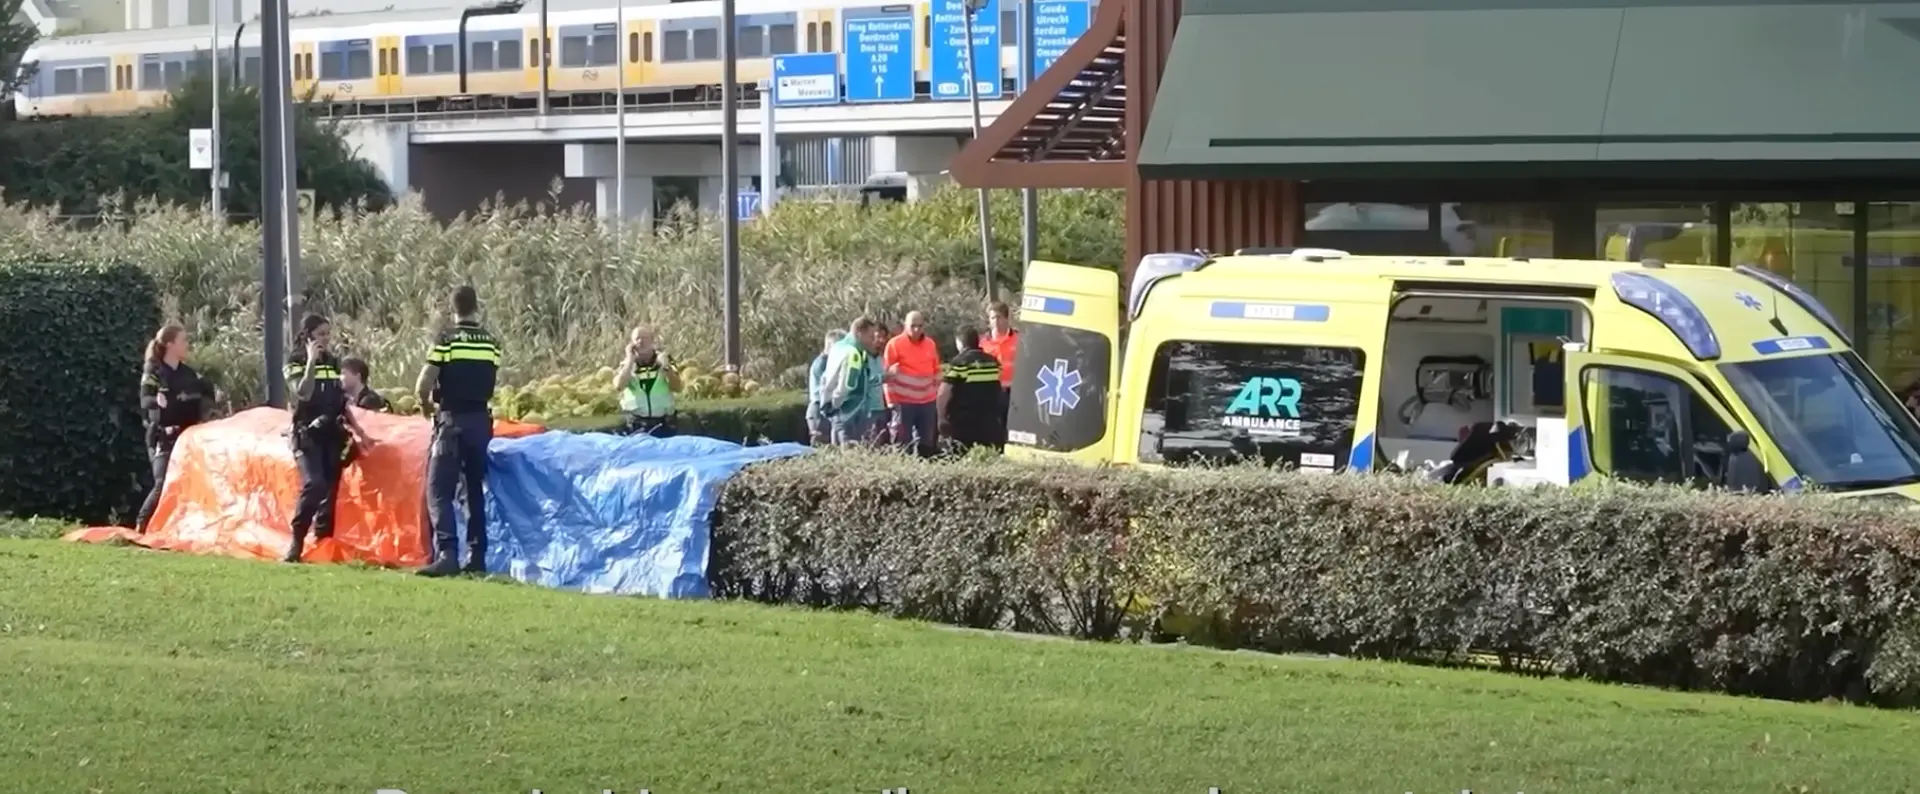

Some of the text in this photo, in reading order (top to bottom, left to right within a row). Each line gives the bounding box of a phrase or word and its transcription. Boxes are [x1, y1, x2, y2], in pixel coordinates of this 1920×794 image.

[1039, 4, 1067, 13] Gouda
[1037, 15, 1069, 24] Utrecht
[950, 25, 996, 35] Zevkamp
[859, 32, 900, 42] Dordrecht
[1037, 37, 1079, 46] Zevenka
[860, 43, 899, 53] Den Haag
[871, 64, 888, 73] A16
[1225, 376, 1302, 417] ARR
[1222, 416, 1301, 430] AMBULANCE
